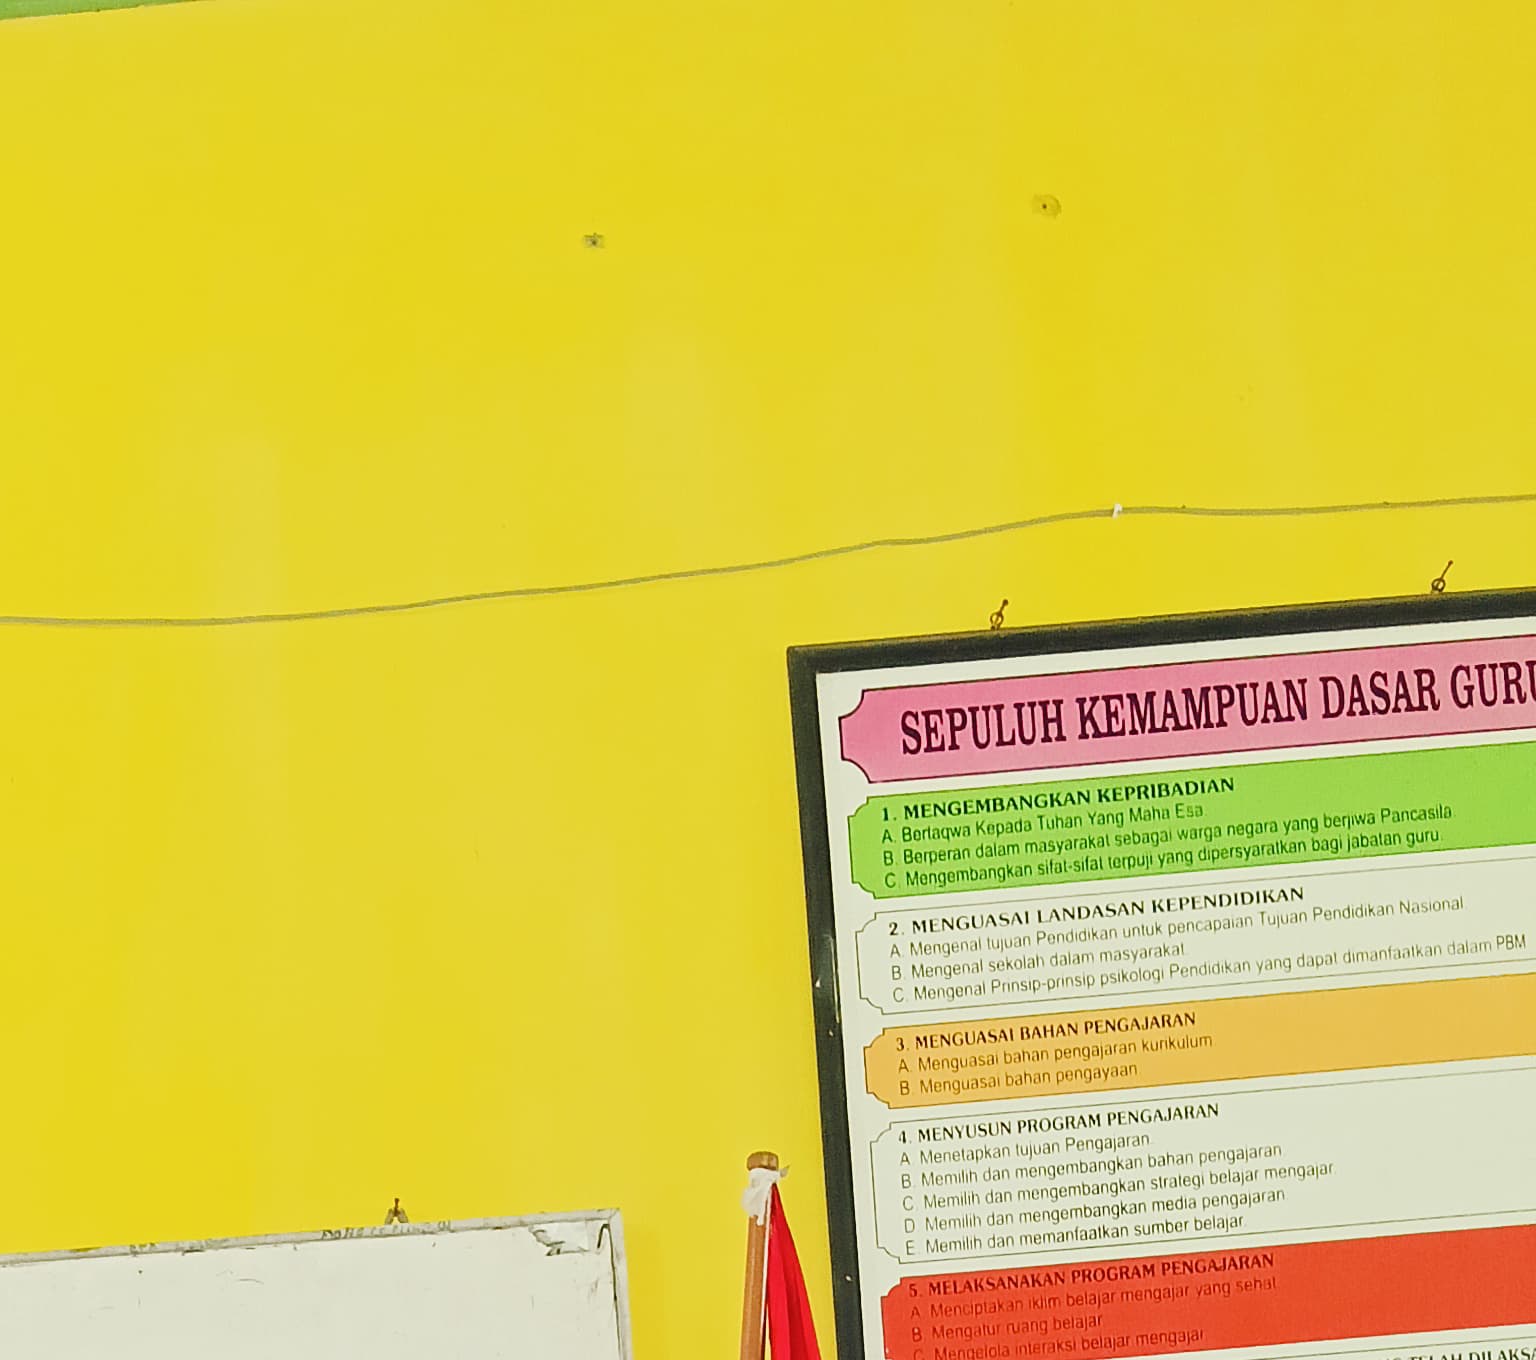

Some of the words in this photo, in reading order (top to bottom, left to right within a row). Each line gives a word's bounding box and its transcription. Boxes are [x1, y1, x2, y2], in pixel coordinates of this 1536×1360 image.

[900, 701, 1067, 756] SEPULUH
[1076, 680, 1308, 741] KEMAMPUAN
[1321, 670, 1441, 719] DASAR
[883, 807, 897, 822] 1.
[903, 789, 1091, 820] MENGEMBANGKAN
[1096, 776, 1234, 803] KEPRIBADIAN
[901, 824, 971, 843] Bertaqwa
[975, 816, 1033, 838] Kepada
[1036, 813, 1083, 831] Tuhan
[1087, 810, 1124, 829] Yang
[1128, 805, 1171, 823] Maha
[903, 846, 971, 866] Berperan
[975, 841, 1020, 859] dalam
[1024, 832, 1111, 855] masyarakat
[1114, 829, 1173, 847] sebagai
[1176, 825, 1222, 843] warga
[1226, 820, 1279, 839] negara
[1282, 816, 1319, 836] yang
[1323, 811, 1376, 830] berjiwa
[905, 863, 1033, 888] Mengembangkan
[1037, 854, 1104, 876] sifat-sifat
[1107, 853, 1154, 871] terpuji
[1157, 849, 1194, 869] yang
[1197, 838, 1307, 864] dipersyaratkan
[1311, 833, 1343, 855] bagi
[1347, 831, 1402, 853] jabatan
[888, 921, 904, 936] 2.
[912, 909, 1030, 934] MENGUASAI
[1037, 899, 1145, 923] LANDASAN
[1151, 886, 1304, 913] KEPENDIDIKAN
[896, 1036, 912, 1051] 3.
[915, 1027, 1014, 1050] MENGUASAI
[1020, 1021, 1079, 1041] BAHAN
[1084, 1011, 1196, 1035] PENGAJARAN
[898, 1129, 914, 1144] 4.
[918, 1120, 1012, 1143] MENYUSUN
[1017, 1112, 1101, 1134] PROGRAM
[1107, 1102, 1219, 1126] PENGAJARAN
[928, 1270, 1066, 1296] MELAKSANAKAN
[1071, 1262, 1156, 1284] PROGRAM
[1160, 1251, 1274, 1277] PENGAJARAN
